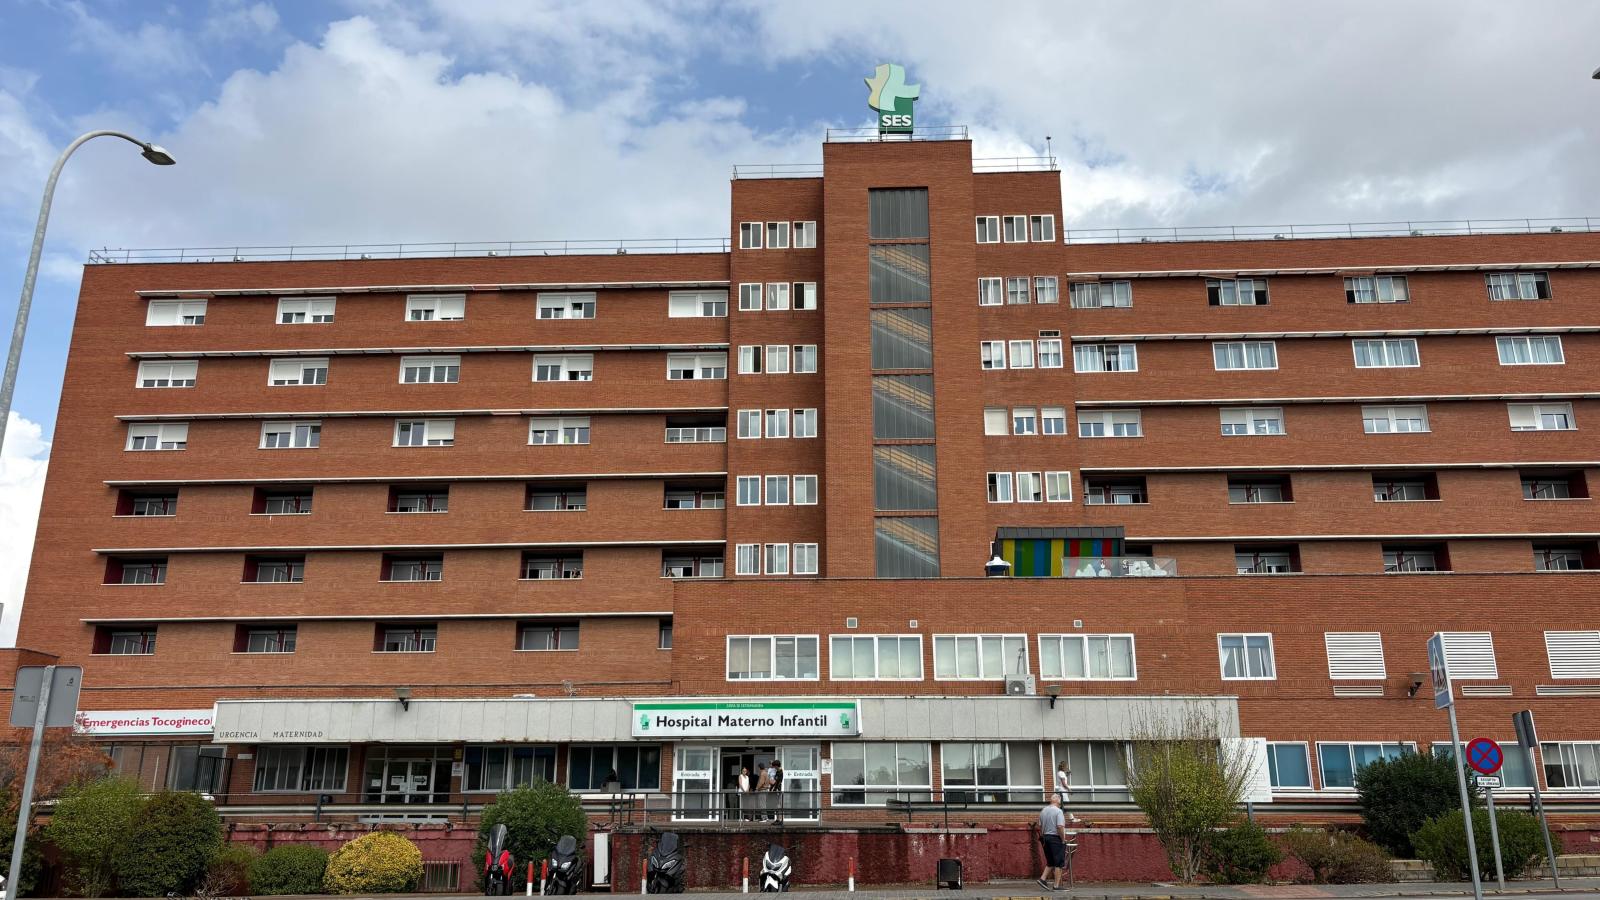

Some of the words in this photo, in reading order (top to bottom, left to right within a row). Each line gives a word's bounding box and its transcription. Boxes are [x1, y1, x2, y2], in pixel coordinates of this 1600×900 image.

[882, 115, 911, 127] SES
[83, 718, 150, 729] Emergencias
[656, 715, 712, 731] Hospital
[718, 715, 774, 727] Materno
[780, 715, 827, 727] Infantil
